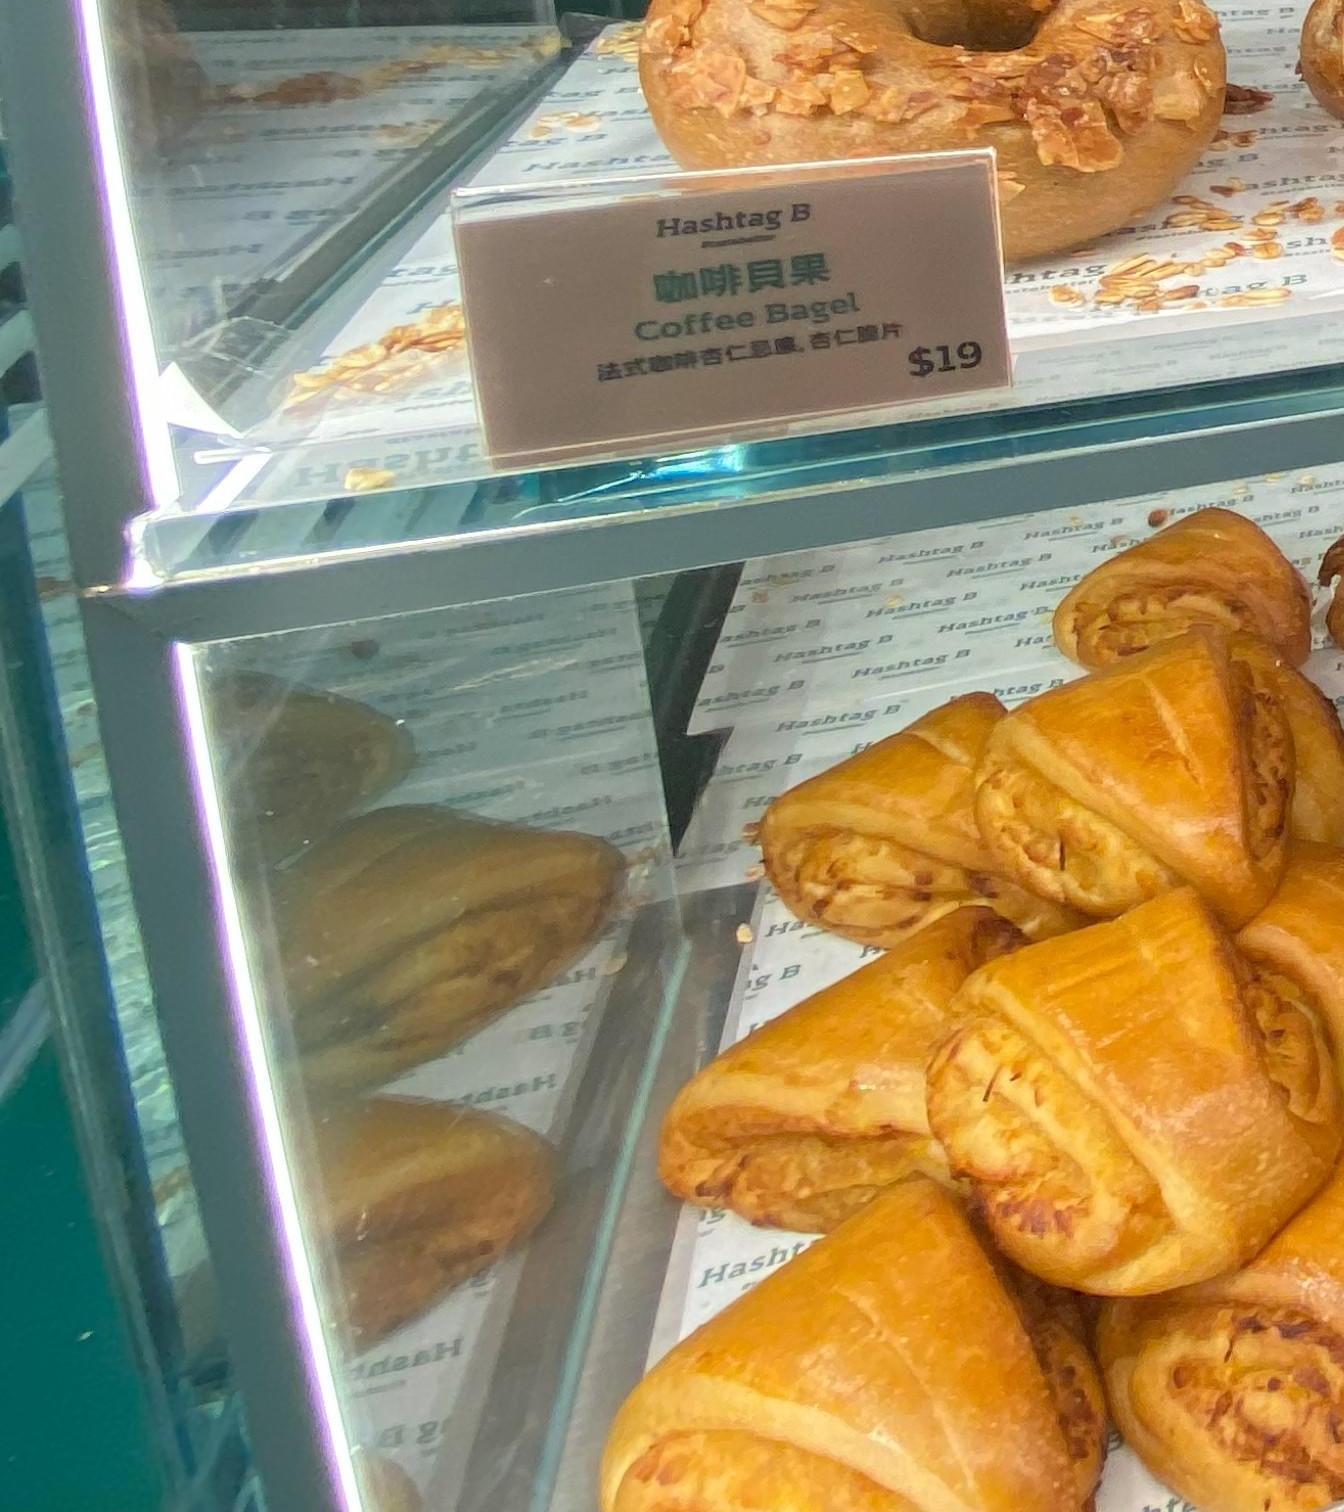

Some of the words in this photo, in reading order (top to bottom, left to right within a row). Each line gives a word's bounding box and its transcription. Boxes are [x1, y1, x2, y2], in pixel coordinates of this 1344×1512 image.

[656, 207, 782, 240] Hashtag
[791, 203, 811, 223] B
[651, 252, 832, 305] 咖啡貝果
[1014, 265, 1107, 284] htag
[635, 310, 755, 343] Coffee
[765, 293, 861, 327] Bagel
[907, 340, 984, 379] $19
[1020, 573, 1081, 592] Hasht
[720, 622, 797, 643] ashtag
[698, 684, 782, 707] ashtag
[993, 682, 1042, 696] htag
[776, 708, 877, 733] Hashtag
[884, 704, 901, 715] B
[714, 757, 776, 775] htag
[780, 965, 801, 980] B
[697, 1241, 804, 1288] Hasht
